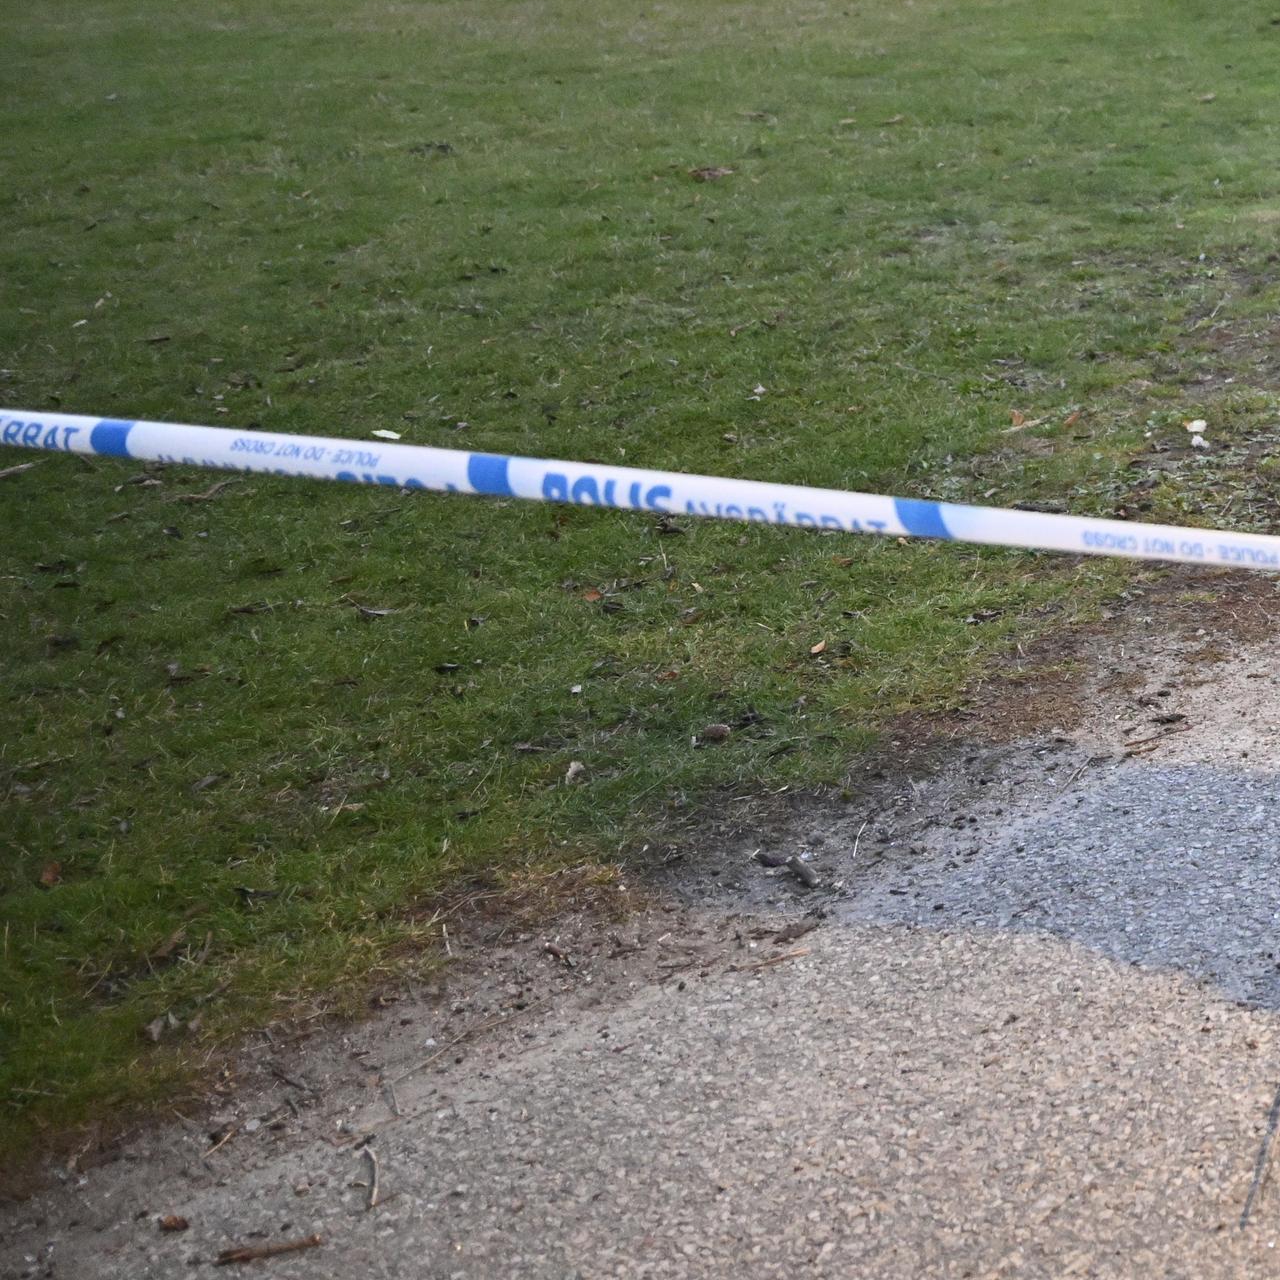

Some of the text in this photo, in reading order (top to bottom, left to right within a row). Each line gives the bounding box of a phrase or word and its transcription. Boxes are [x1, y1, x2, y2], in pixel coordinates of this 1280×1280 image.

[0, 419, 79, 451] RRAT
[230, 438, 273, 457] CROSS
[277, 443, 301, 459] NOT
[303, 445, 325, 461] DO
[331, 448, 381, 468] POLICE
[1081, 529, 1138, 551] CROSS
[1143, 536, 1175, 554] NOT
[1180, 540, 1204, 558] DO
[1217, 544, 1280, 566] POLICE
